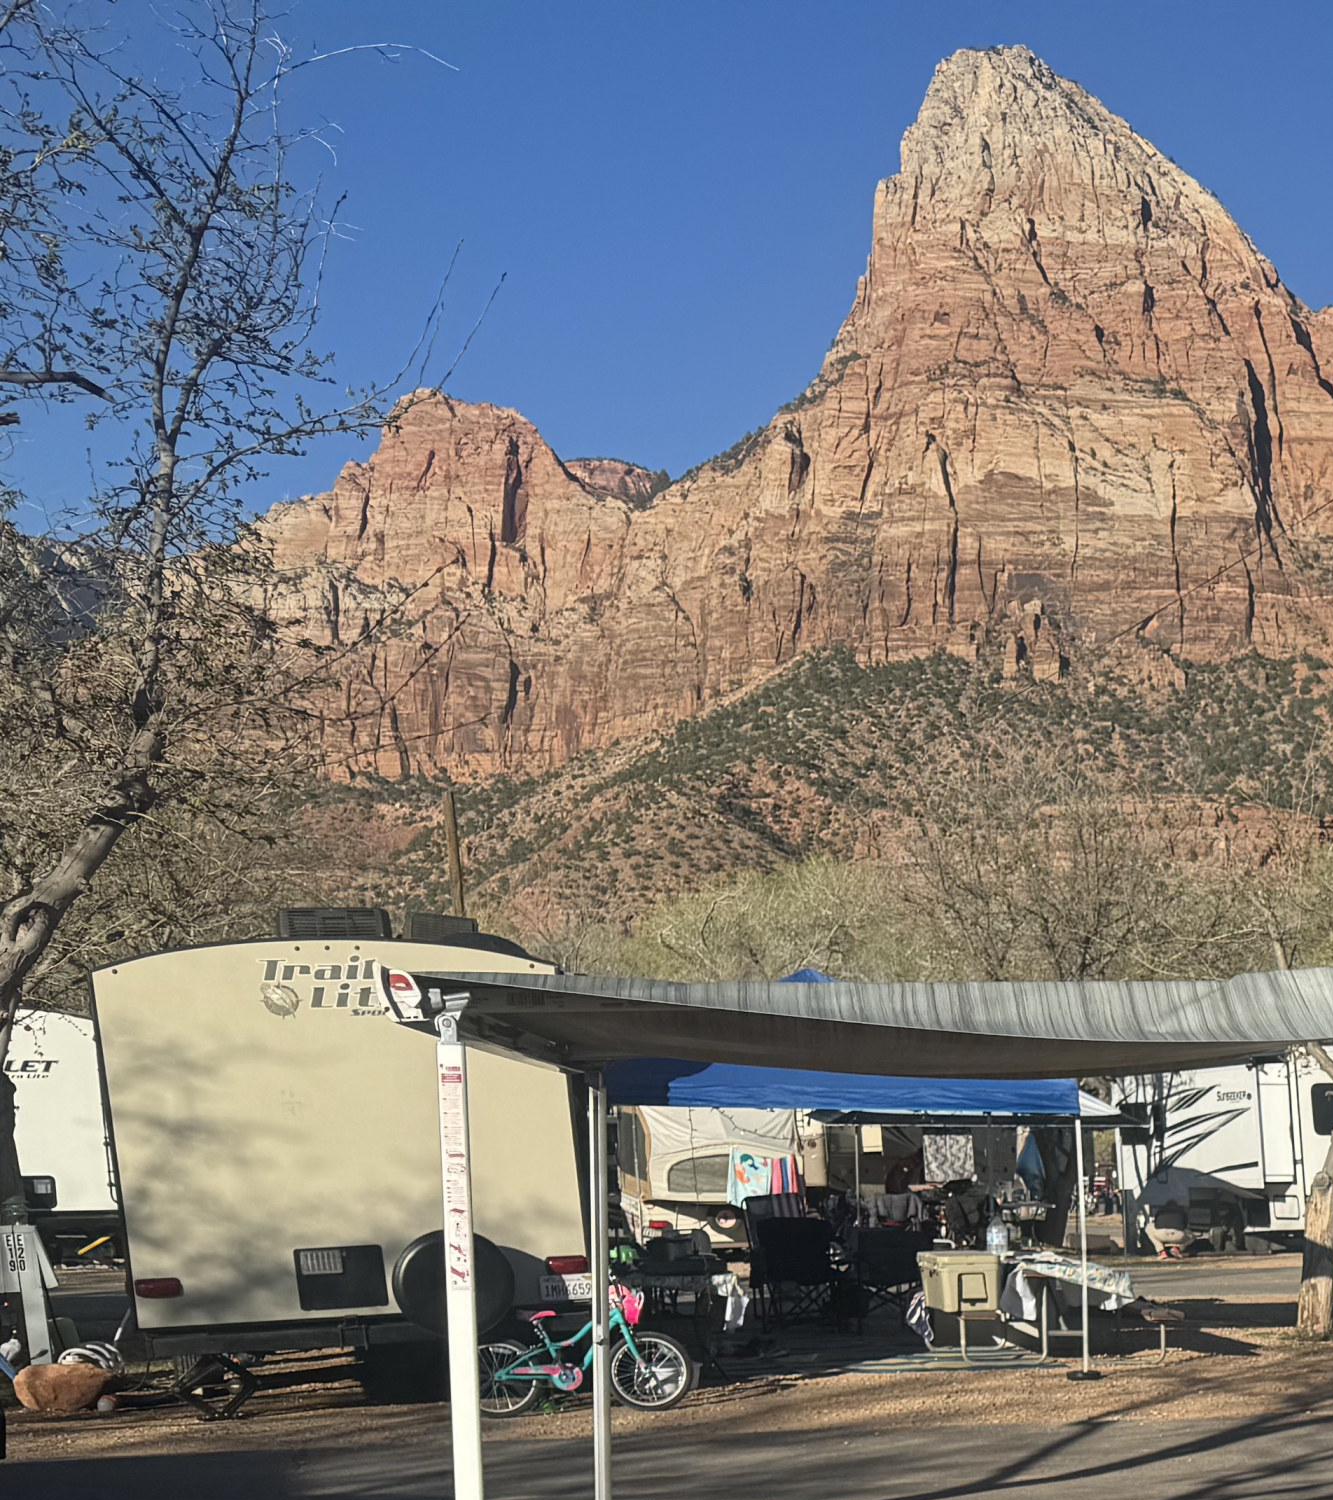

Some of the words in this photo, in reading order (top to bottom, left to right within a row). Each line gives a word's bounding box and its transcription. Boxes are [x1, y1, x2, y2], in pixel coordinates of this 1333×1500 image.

[257, 955, 376, 981] Trail
[311, 983, 379, 1008] Lit
[4, 1060, 59, 1073] LET
